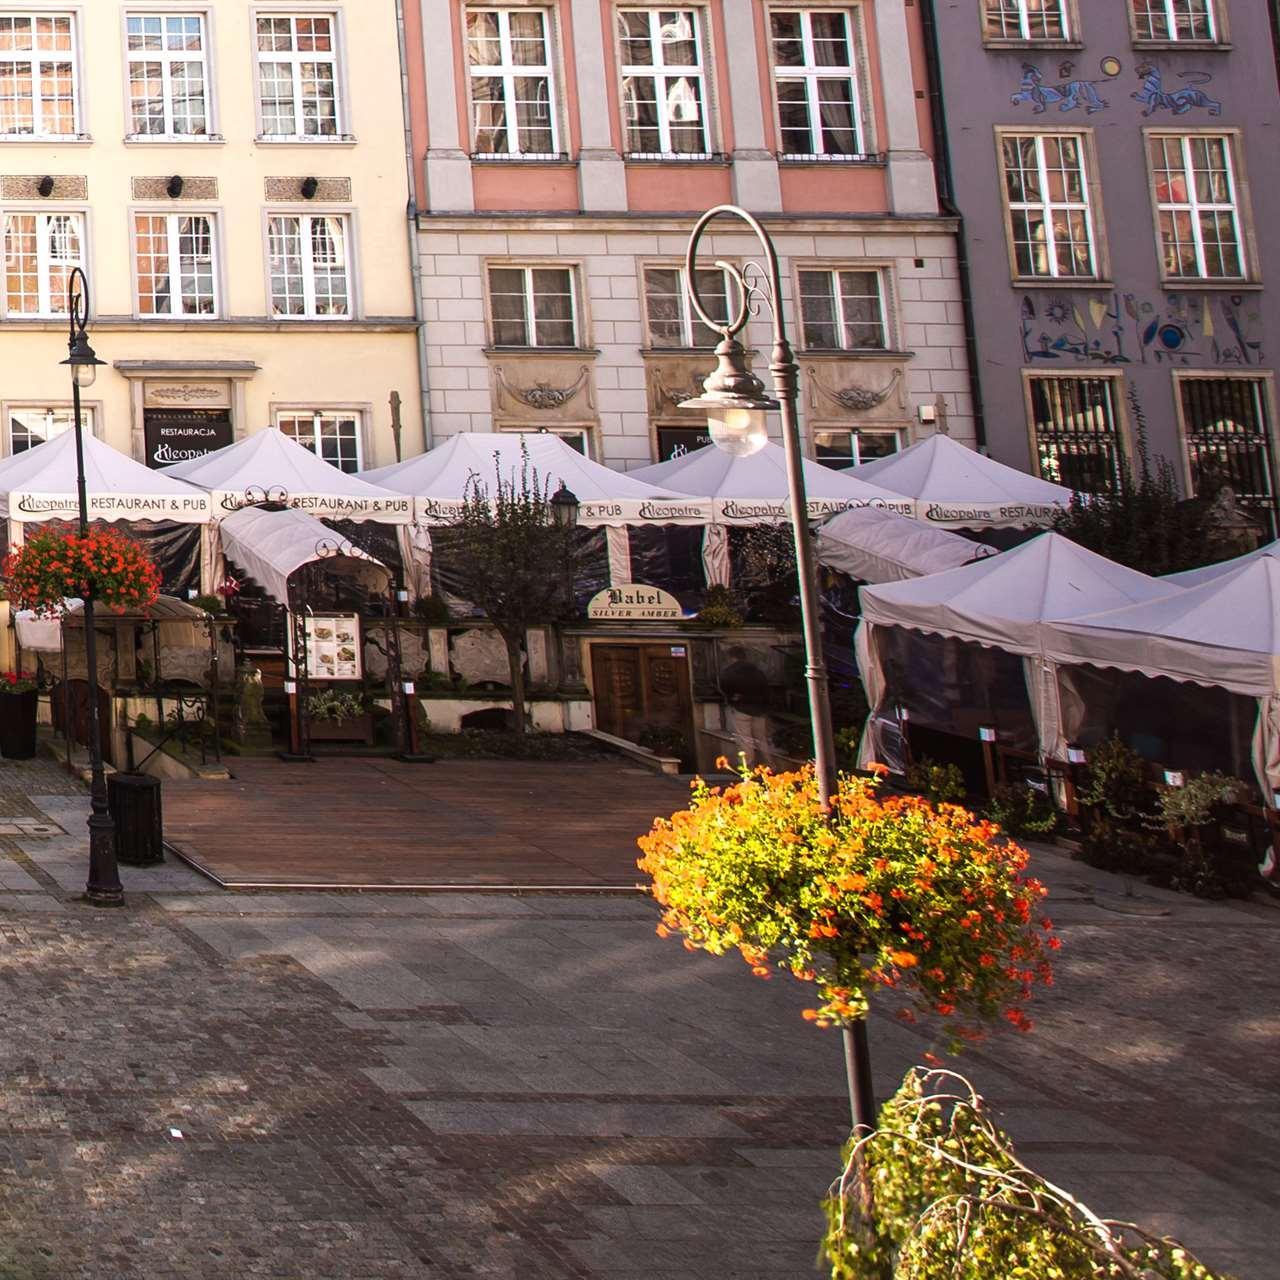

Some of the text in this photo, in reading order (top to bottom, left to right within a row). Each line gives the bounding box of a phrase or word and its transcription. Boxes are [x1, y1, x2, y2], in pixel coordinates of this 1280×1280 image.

[160, 428, 216, 436] RESTAURACJA
[91, 498, 166, 510] RESTAURANT
[170, 499, 180, 510] &
[183, 499, 207, 510] PUB
[293, 498, 368, 510] RESTAURANT
[372, 501, 382, 511] &
[385, 500, 409, 511] PUB
[721, 501, 788, 519] Kleopatra
[586, 506, 596, 517] &
[598, 505, 622, 516] PUB
[638, 502, 705, 520] Kleopatra
[925, 503, 994, 522] Kleopatra
[606, 588, 663, 608] Babel
[592, 609, 632, 617] SILVER
